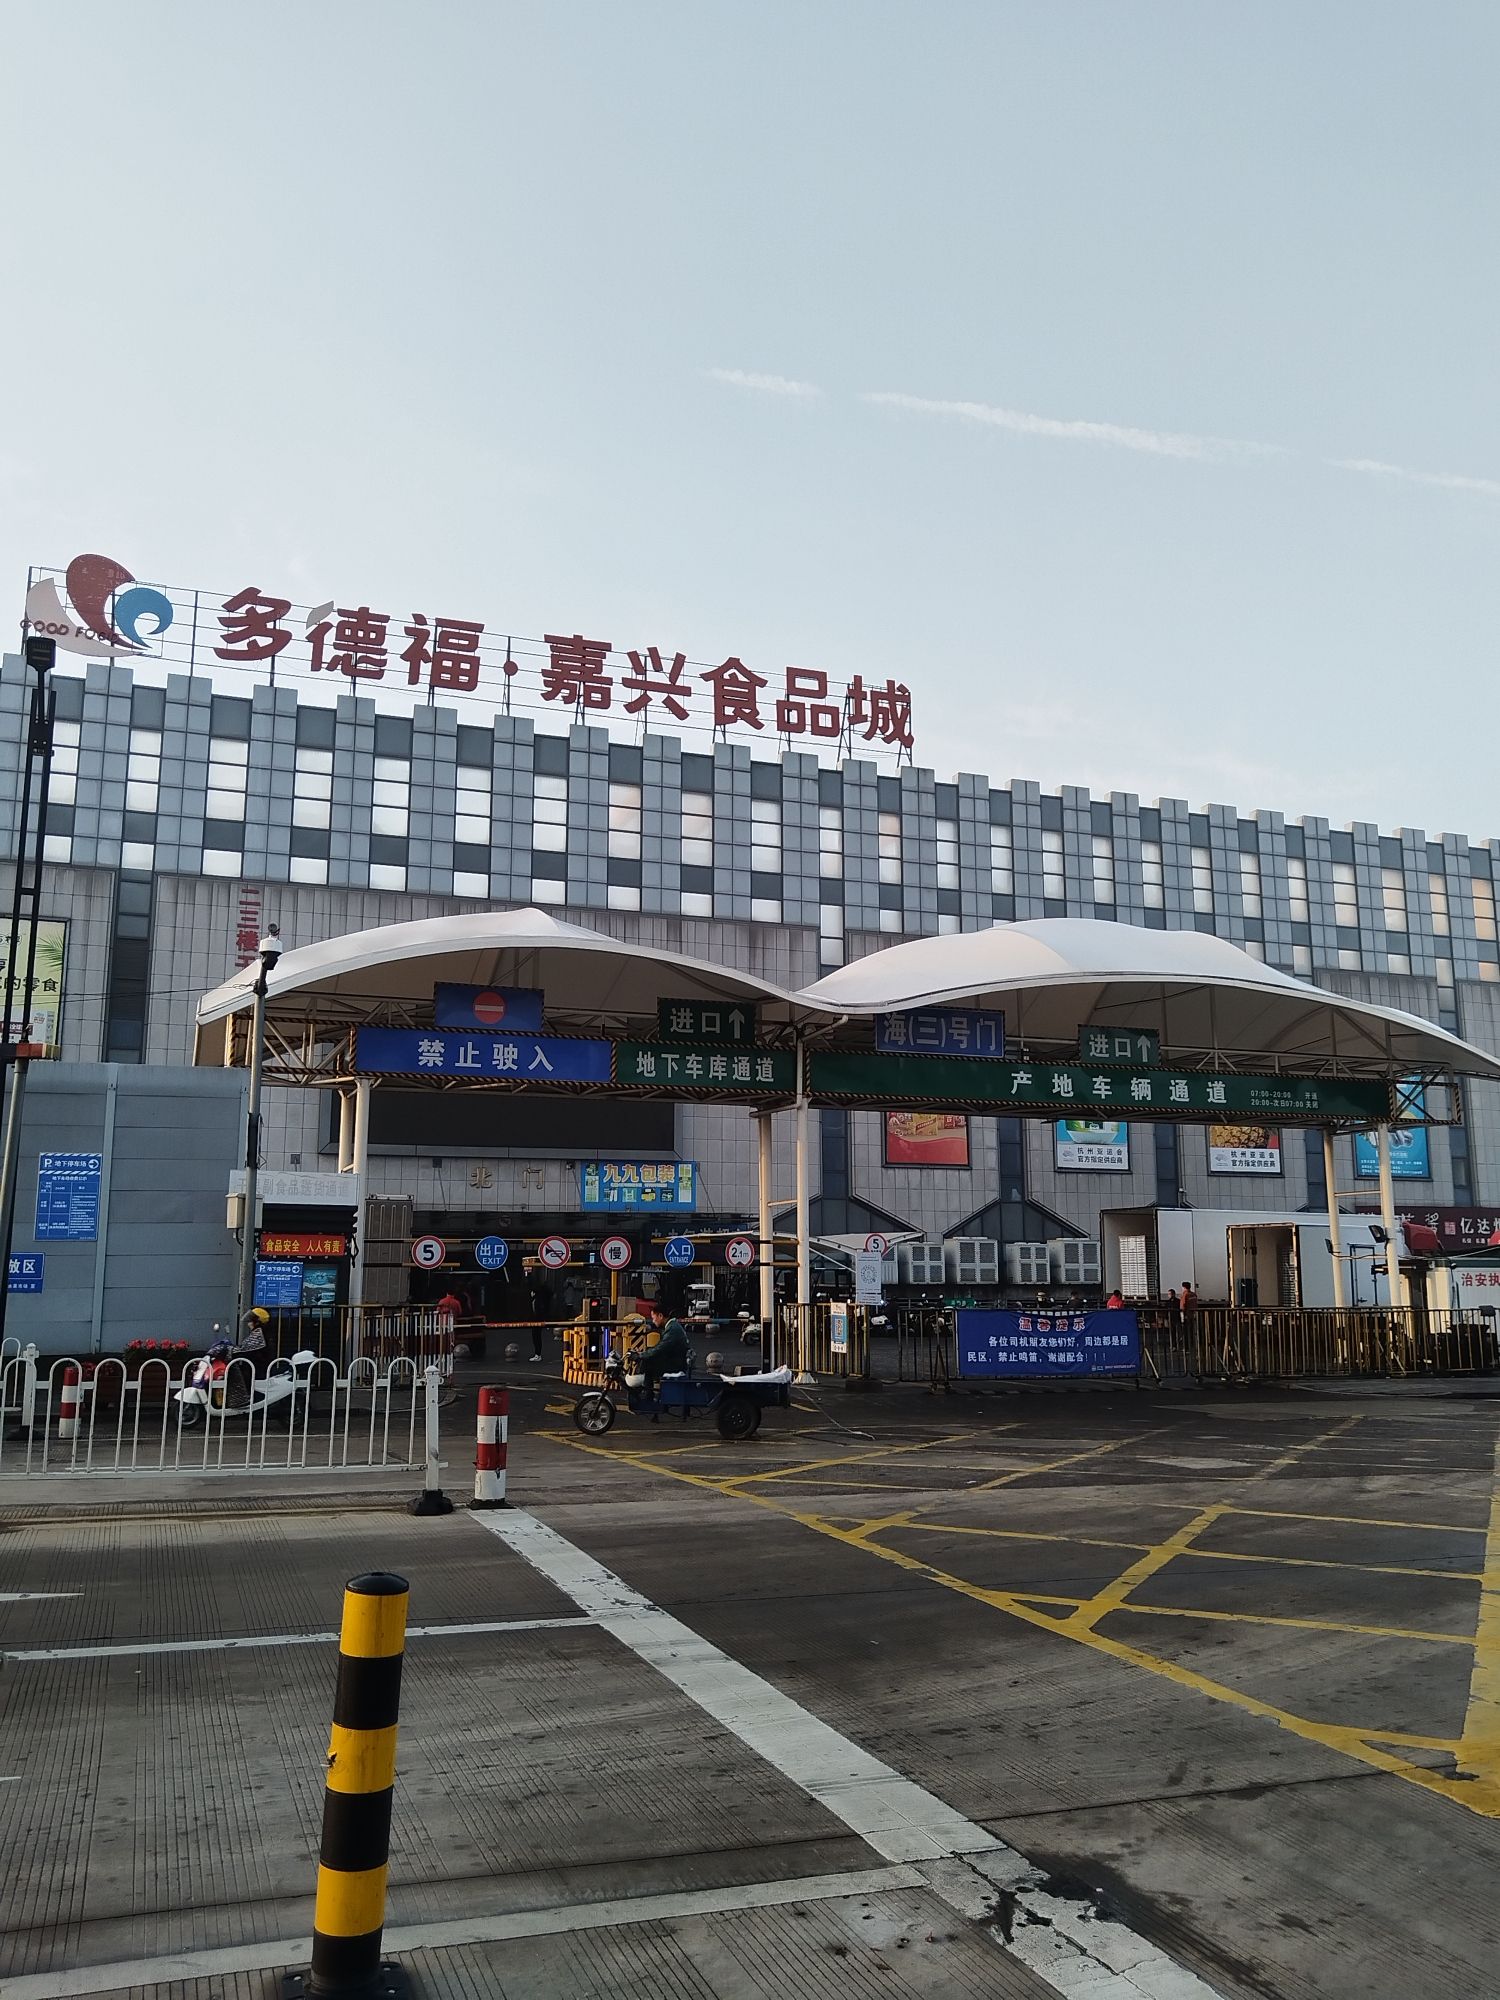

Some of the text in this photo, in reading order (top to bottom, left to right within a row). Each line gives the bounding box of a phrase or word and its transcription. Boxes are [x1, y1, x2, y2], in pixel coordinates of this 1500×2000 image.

[20, 619, 70, 635] GOOD
[669, 1007, 722, 1035] 进口
[1088, 1033, 1132, 1058] 进口
[417, 1038, 555, 1073] 禁止驶入
[636, 1050, 775, 1084] 地下车库通道
[1010, 1070, 1228, 1105] 产地车辆通道
[1077, 1147, 1123, 1155] 杭州亚运会
[1230, 1151, 1275, 1159] 杭州亚运会
[1077, 1156, 1123, 1164] 官方指定供应商
[1231, 1159, 1276, 1168] 官方指定供应商
[469, 1166, 544, 1190] 北门
[603, 1163, 676, 1184] 九九包装
[265, 1239, 342, 1253] 食品安全 人人有责
[480, 1243, 504, 1256] 出口
[668, 1244, 691, 1256] 入口
[872, 1239, 880, 1249] 5
[422, 1244, 435, 1262] 5
[609, 1246, 622, 1260] 慢
[669, 1256, 689, 1264] ENTRANCE
[731, 1247, 750, 1259] 2.1m
[482, 1257, 502, 1265] EXIT
[1019, 1317, 1086, 1332] 温馨提示
